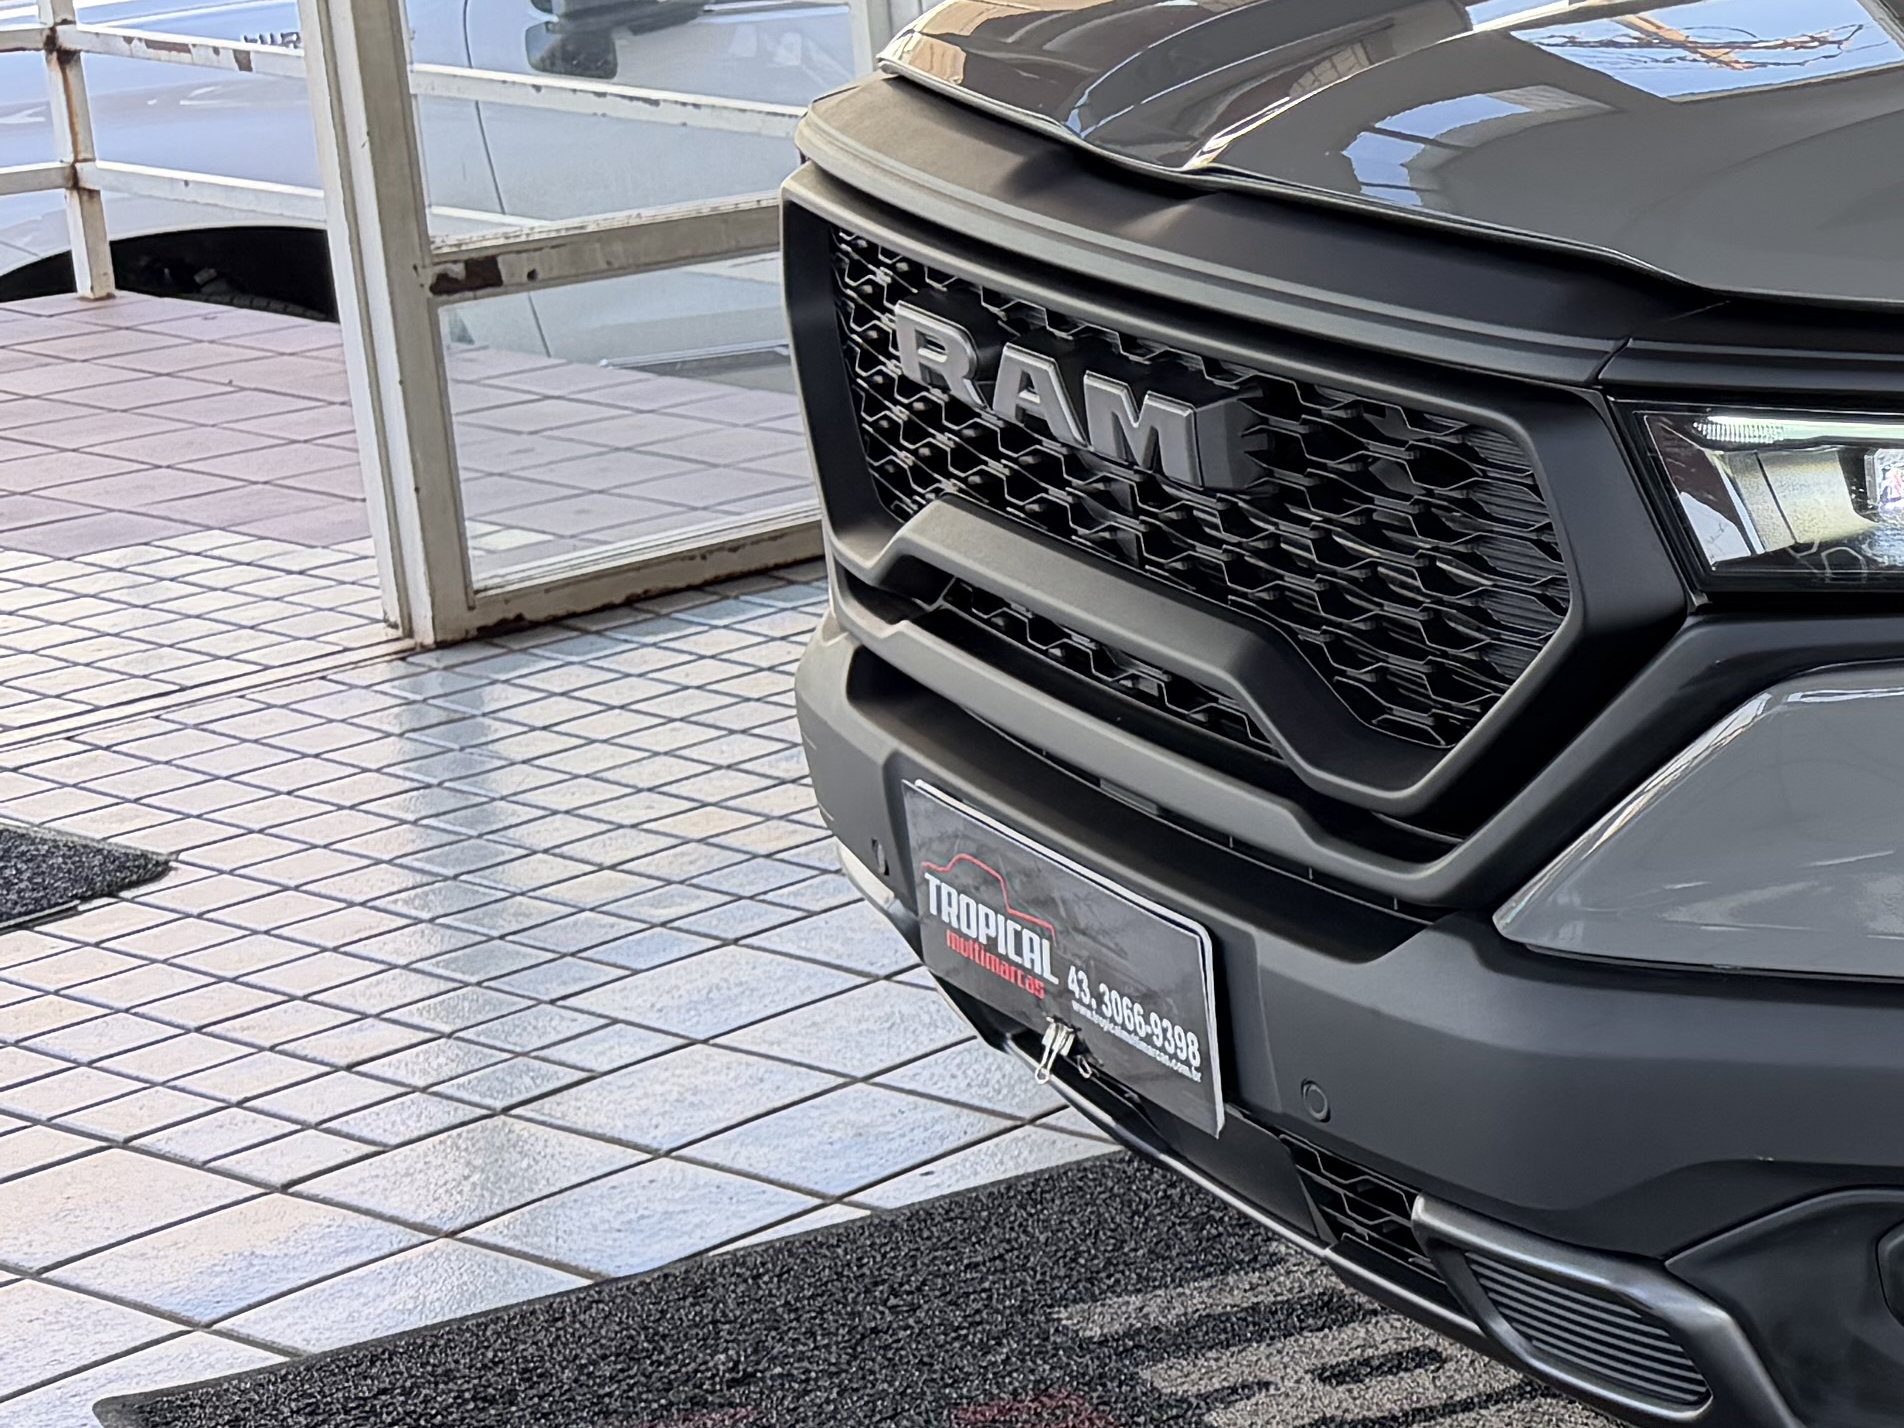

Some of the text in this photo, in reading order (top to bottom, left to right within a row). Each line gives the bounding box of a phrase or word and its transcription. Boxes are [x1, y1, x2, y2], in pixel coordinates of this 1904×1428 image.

[895, 299, 1206, 490] RAM
[924, 872, 1058, 984] TROPICAL
[946, 929, 1045, 999] multimarcas
[1068, 965, 1201, 1068] 43. 3066-9398
